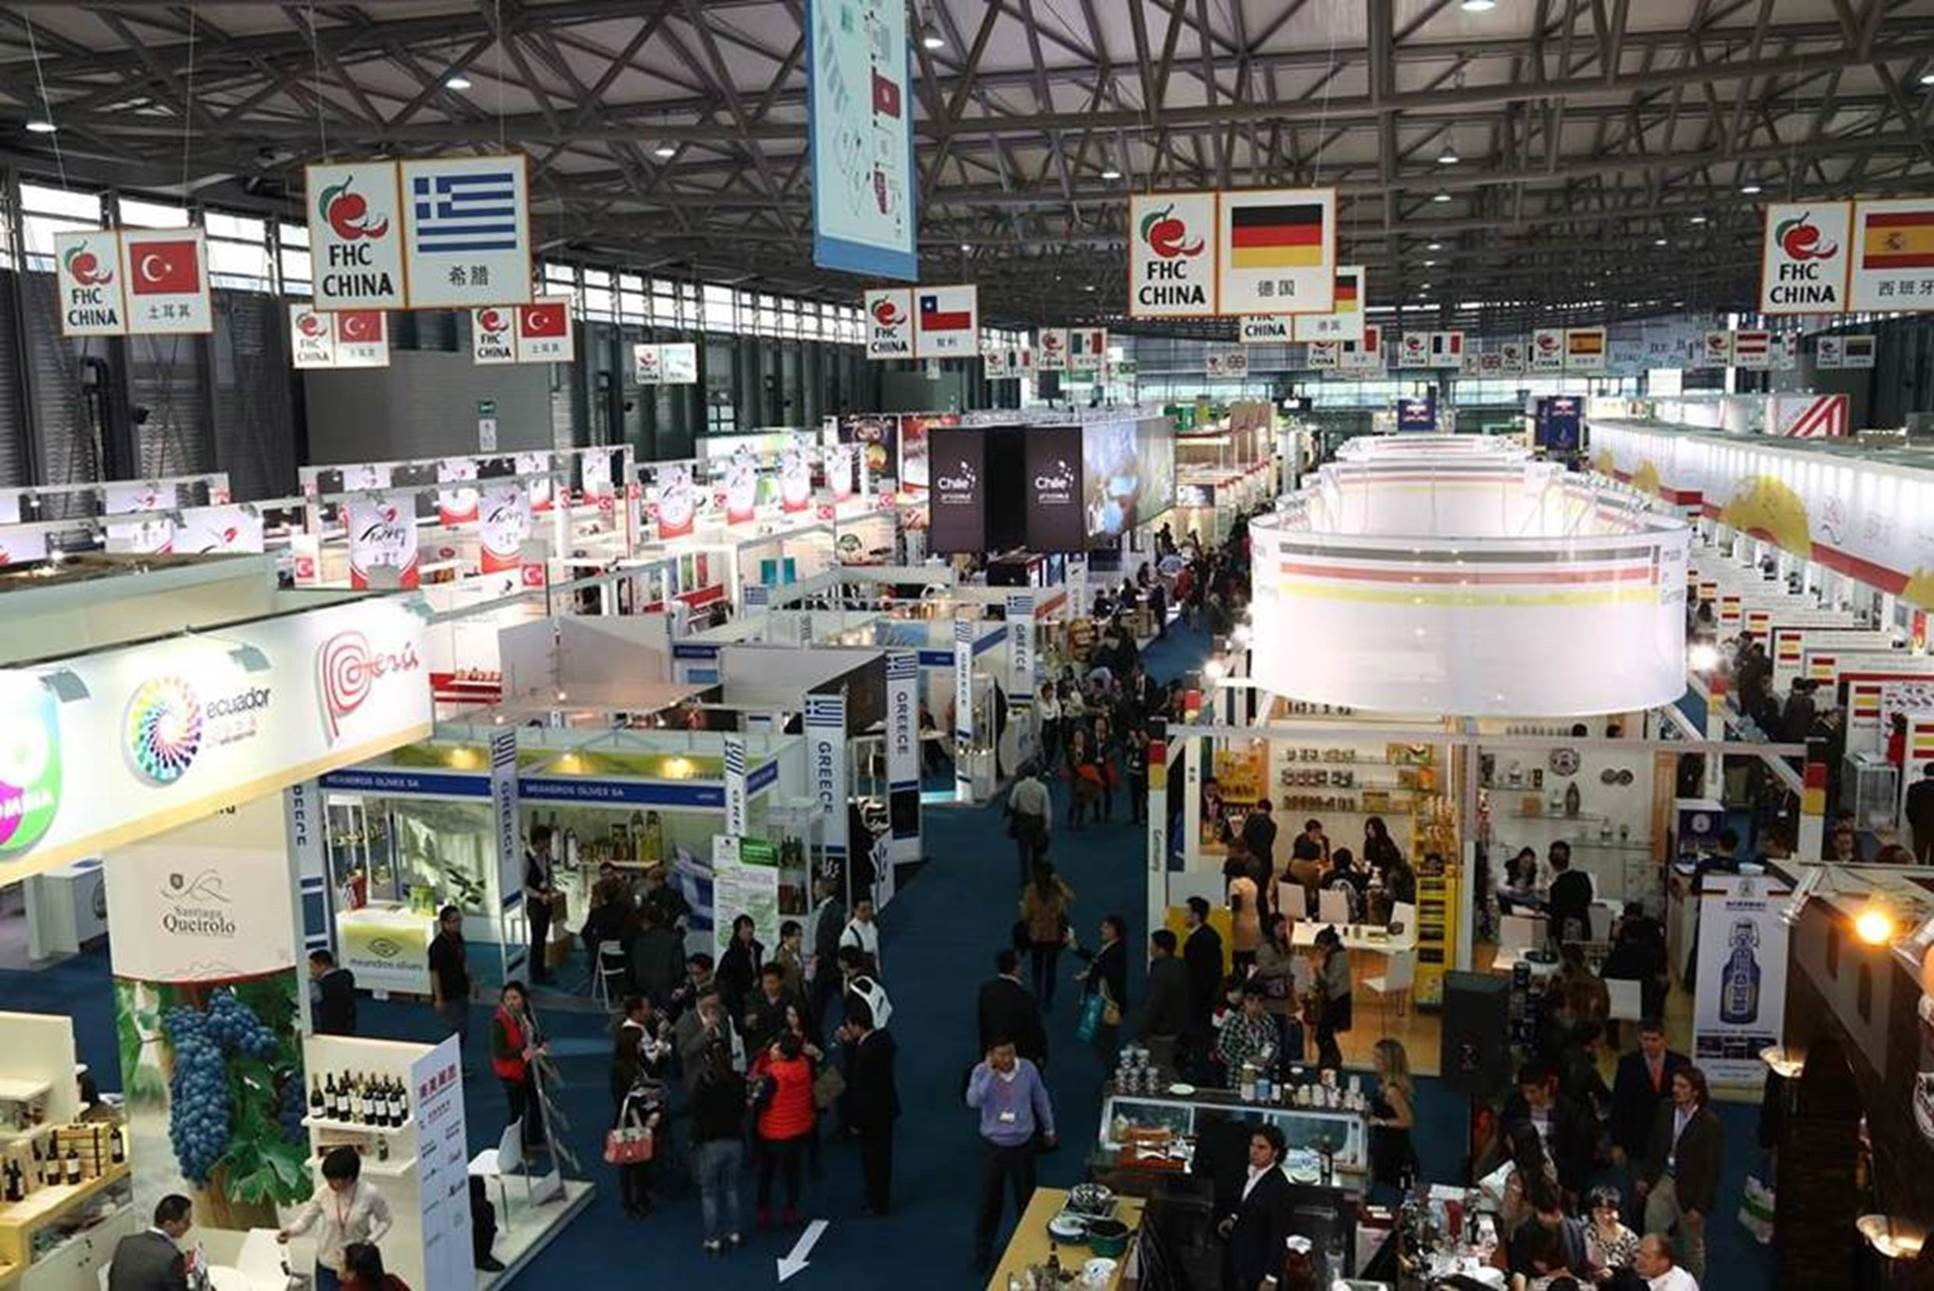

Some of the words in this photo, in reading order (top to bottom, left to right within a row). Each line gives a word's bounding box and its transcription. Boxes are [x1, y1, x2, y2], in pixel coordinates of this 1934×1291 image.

[328, 243, 373, 267] FHC
[1146, 260, 1187, 280] FHC
[1779, 263, 1819, 282] FHC
[322, 272, 395, 297] CHINA
[71, 288, 103, 305] FHC
[1138, 285, 1206, 305] CHINA
[1769, 285, 1836, 304] CHINA
[68, 308, 118, 326] CHINA
[481, 333, 501, 344] FHC
[875, 327, 898, 338] FHC
[1244, 324, 1287, 338] CHINA
[477, 346, 512, 358] CHINA
[870, 340, 908, 353] CHINA
[297, 351, 330, 363] CHINA
[937, 476, 970, 490] Chile
[1034, 476, 1068, 490] Chile
[1015, 623, 1027, 673] GREECE
[206, 687, 271, 719] ecuador
[895, 691, 909, 755] GREECE
[817, 740, 834, 814] GREECE
[500, 780, 513, 859] GREECE
[163, 913, 236, 933] Queirolo
